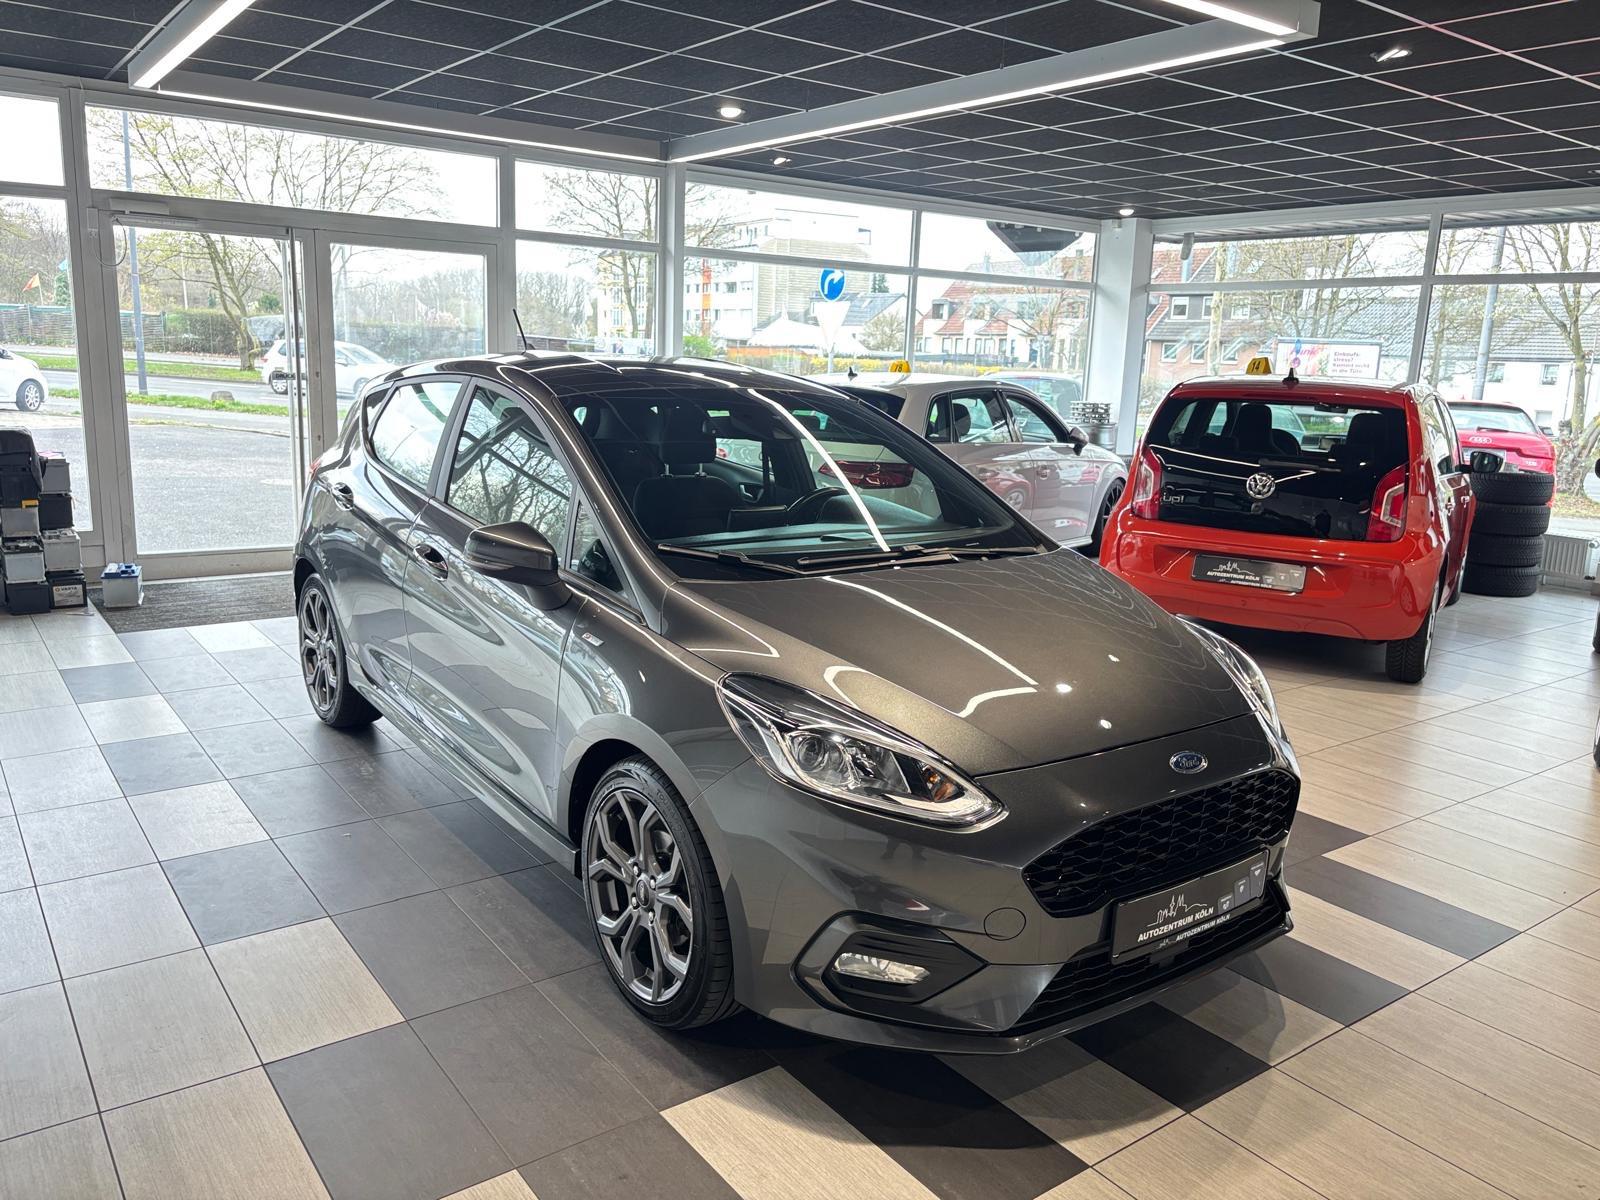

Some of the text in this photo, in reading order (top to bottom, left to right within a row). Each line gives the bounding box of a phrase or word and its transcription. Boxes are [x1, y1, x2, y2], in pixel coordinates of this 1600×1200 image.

[1250, 360, 1262, 372] 14
[1206, 571, 1245, 580] AUTOZENTRUM
[1137, 906, 1214, 942] AUTOZENTRUM KÖLN
[1176, 914, 1230, 942] AUTOZENTRUM KÖLN
